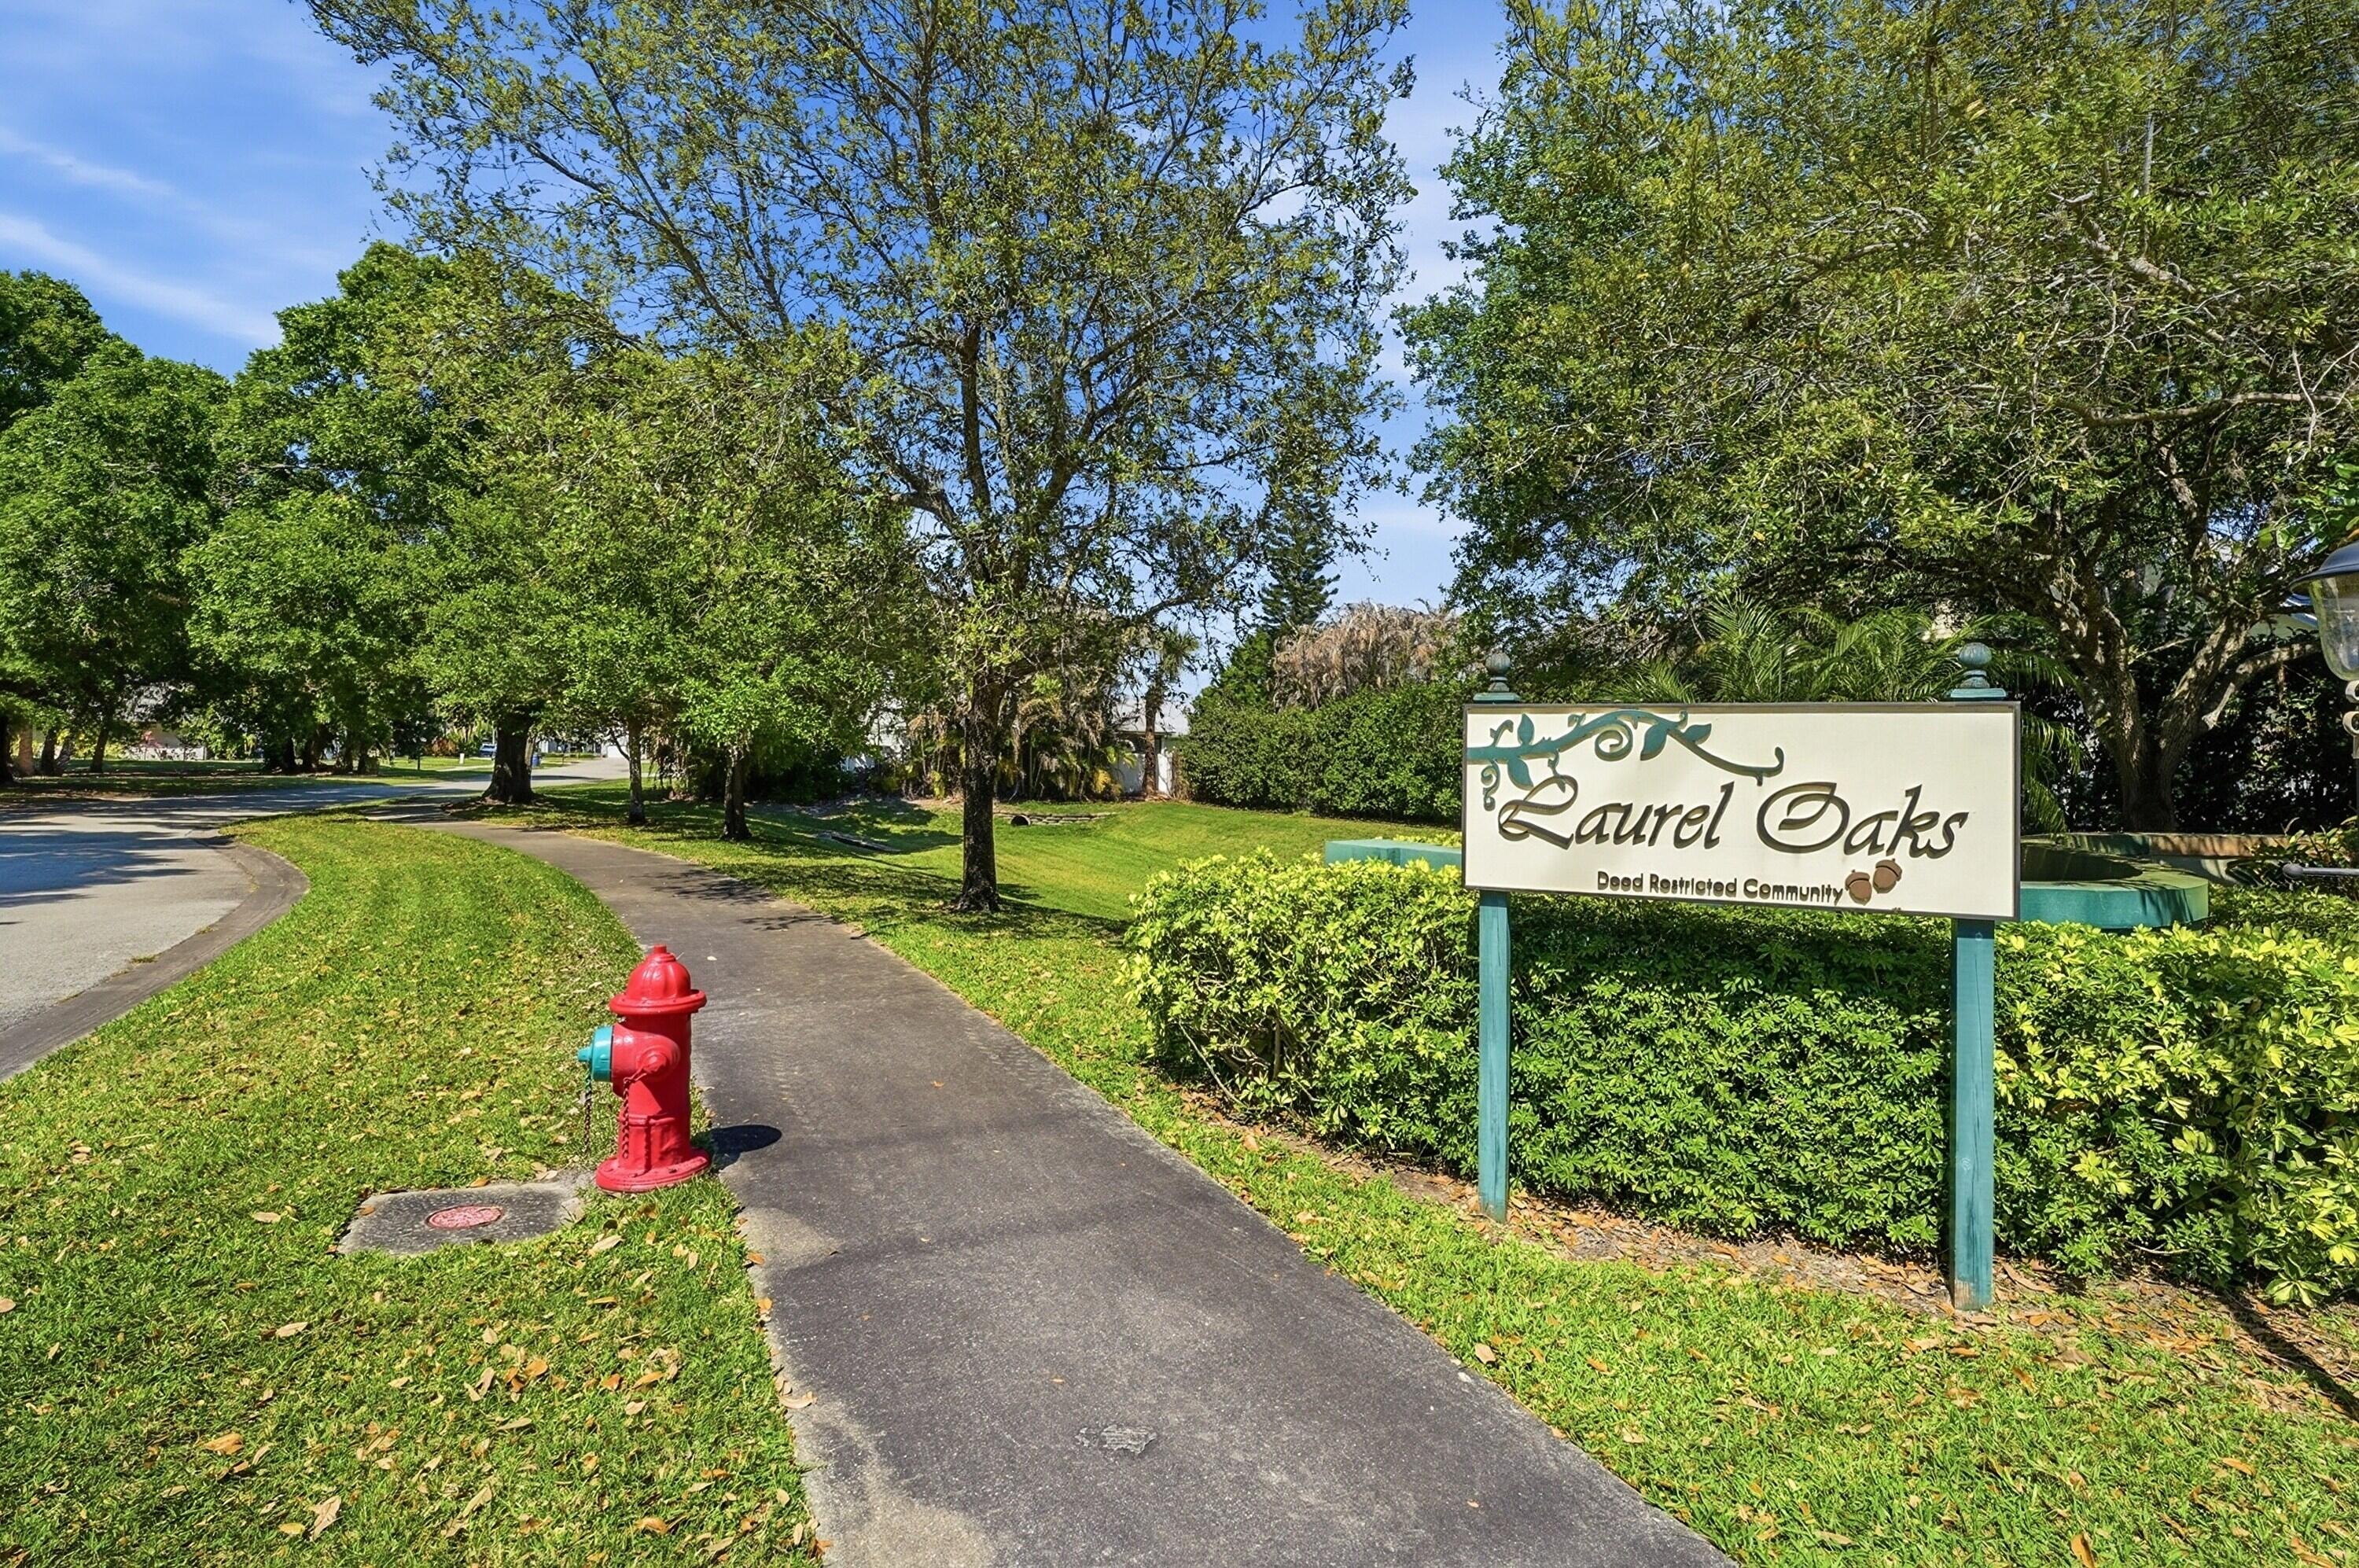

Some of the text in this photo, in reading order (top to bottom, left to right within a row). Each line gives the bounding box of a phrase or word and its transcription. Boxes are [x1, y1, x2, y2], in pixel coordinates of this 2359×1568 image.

[1498, 775, 1969, 859] Laurel Oaks
[1597, 870, 1844, 906] Deed Restricted Community
